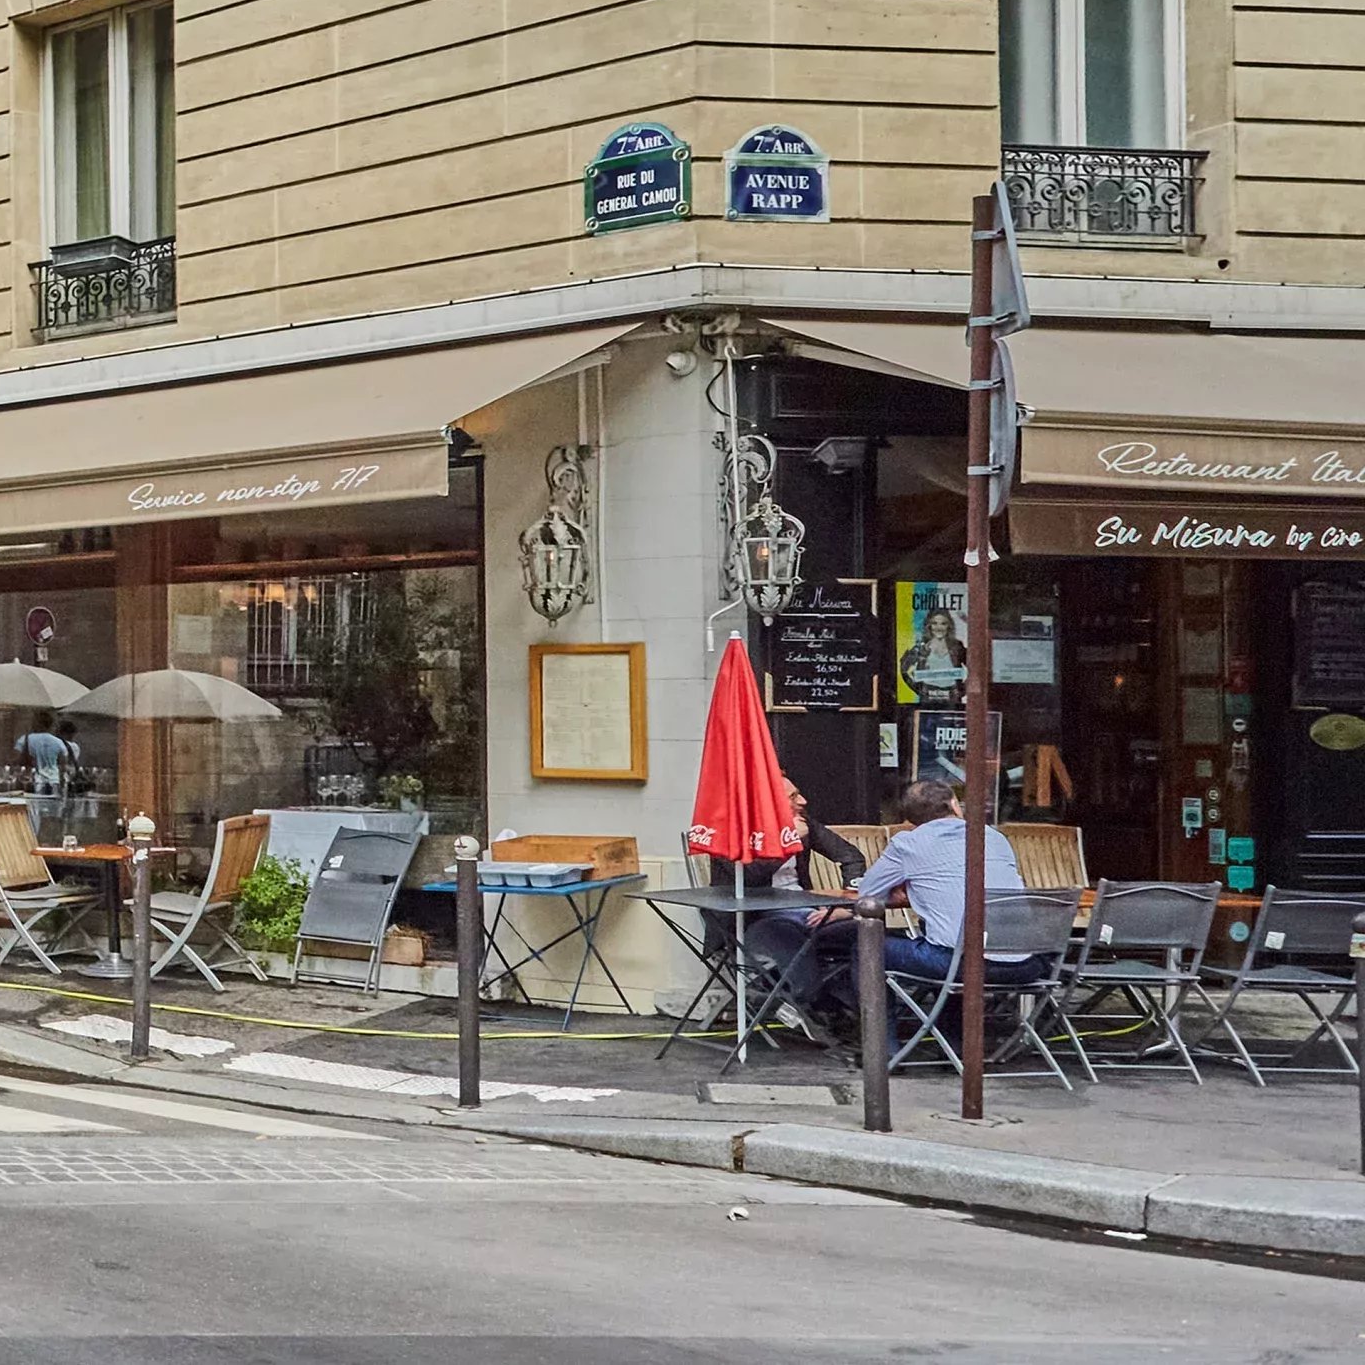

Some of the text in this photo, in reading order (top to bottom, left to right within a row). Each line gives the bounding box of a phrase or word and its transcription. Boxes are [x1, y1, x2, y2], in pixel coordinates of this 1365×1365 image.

[617, 169, 654, 189] RUE DU
[746, 174, 809, 189] AVENUE
[642, 187, 676, 206] CAMOU
[752, 194, 803, 209] RAPP
[1097, 442, 1298, 481] Restaurant
[128, 465, 379, 511] Service non-stop 7/7
[1095, 516, 1363, 551] Su Misura by Ciro
[912, 594, 964, 611] CHOLLET
[936, 727, 967, 742] ADIE
